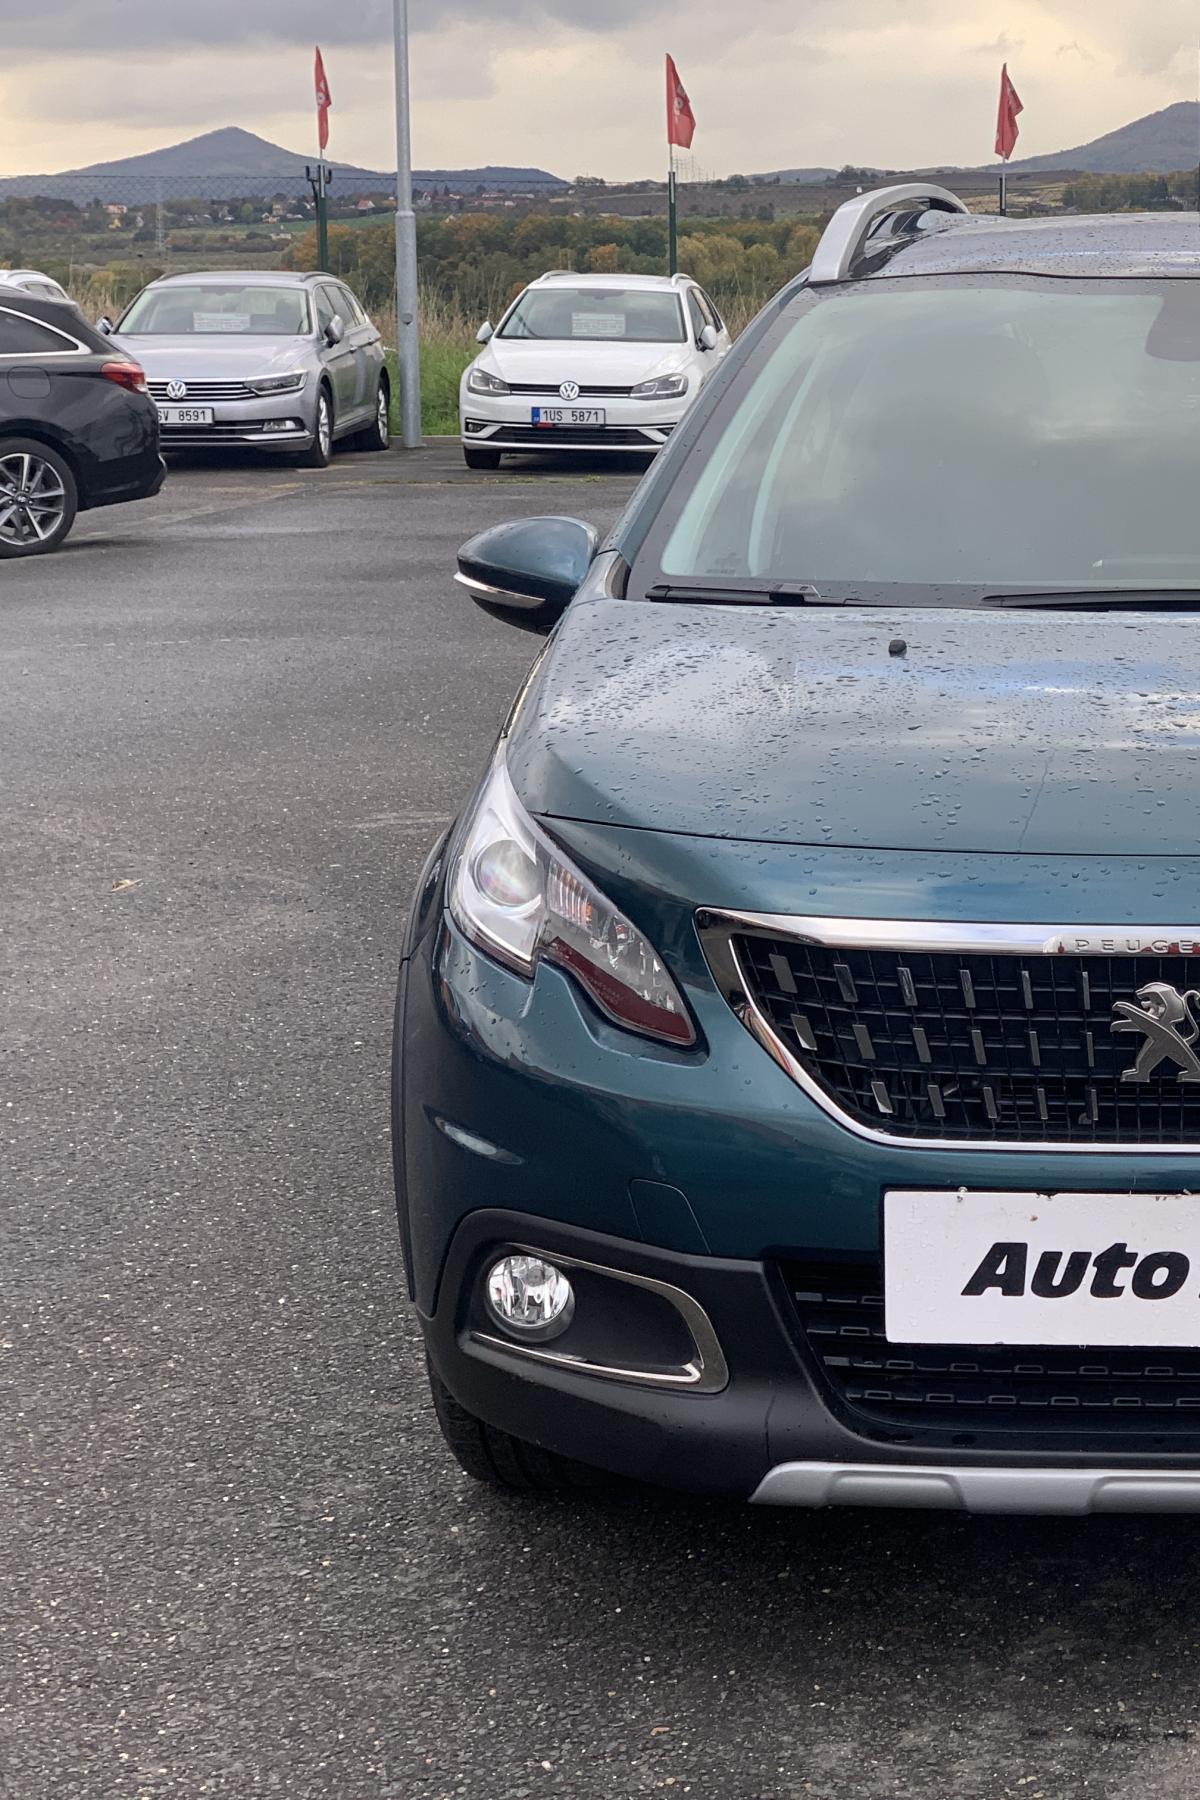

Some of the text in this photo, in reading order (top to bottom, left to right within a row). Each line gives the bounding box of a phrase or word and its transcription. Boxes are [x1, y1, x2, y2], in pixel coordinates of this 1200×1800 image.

[178, 410, 206, 421] 8591
[543, 410, 599, 422] 1US 5871
[960, 1242, 1191, 1300] Auto
